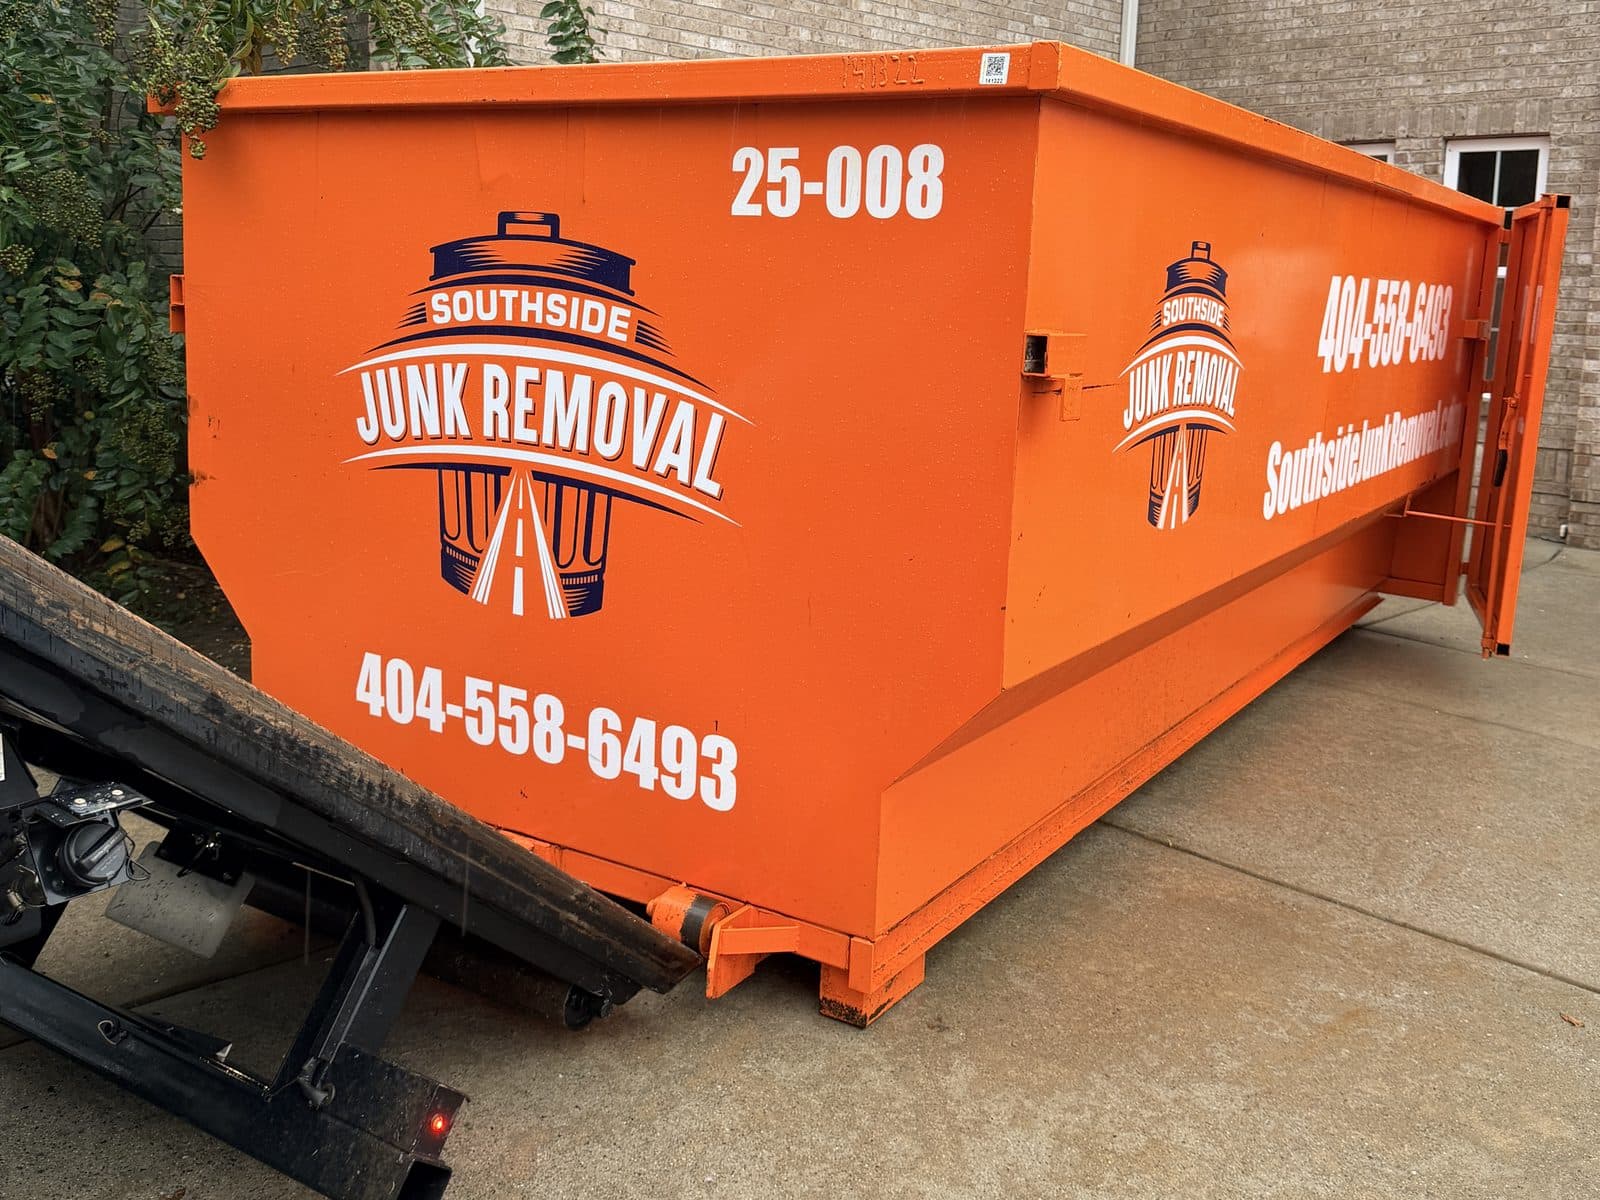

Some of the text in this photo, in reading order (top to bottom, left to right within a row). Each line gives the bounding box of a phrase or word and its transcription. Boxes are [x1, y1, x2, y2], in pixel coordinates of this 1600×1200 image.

[731, 143, 944, 219] 25-008
[431, 289, 632, 342] SOUTHSIDE
[1162, 297, 1224, 327] SOUTHSIDE
[1318, 275, 1453, 373] 404-558-6493
[356, 363, 727, 500] JUNK REMOVAL
[1123, 350, 1241, 431] JUNK REMOVAL
[1263, 400, 1463, 521] SouthsideJunkRemoval.c
[356, 652, 738, 812] 404-558-6493
